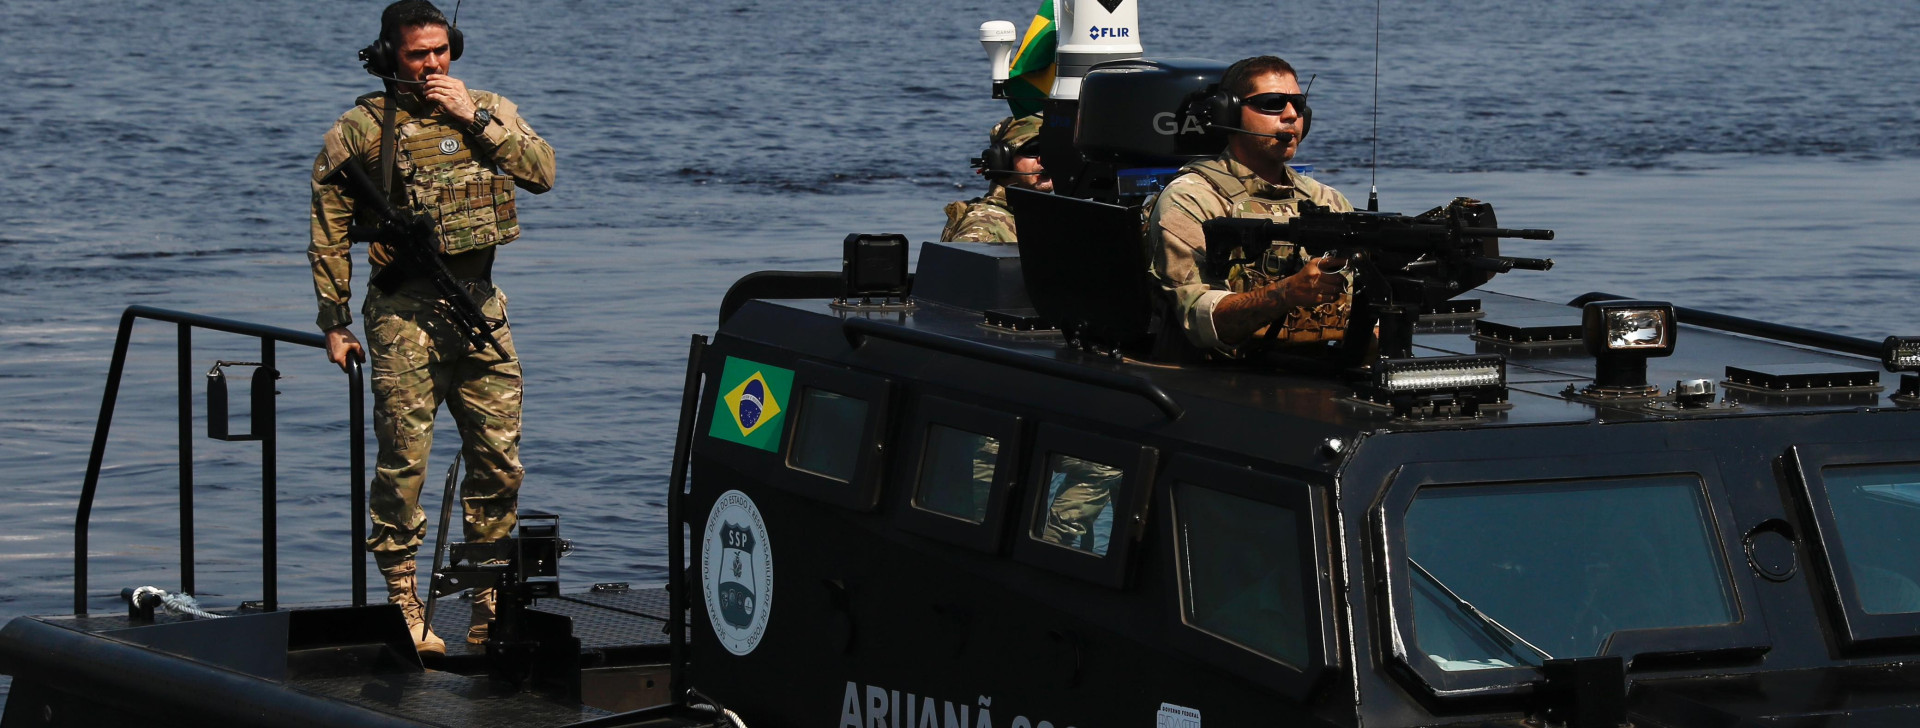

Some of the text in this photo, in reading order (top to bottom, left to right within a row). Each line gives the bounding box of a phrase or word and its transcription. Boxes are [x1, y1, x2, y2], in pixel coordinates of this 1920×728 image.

[1101, 27, 1129, 37] FLIR
[720, 498, 728, 511] DO
[729, 495, 747, 509] ESTADO
[709, 506, 720, 533] DEVER
[729, 529, 748, 548] SSP
[752, 508, 771, 607] RESPONSABILIDADE
[760, 608, 767, 624] DE
[747, 623, 762, 647] TODOS
